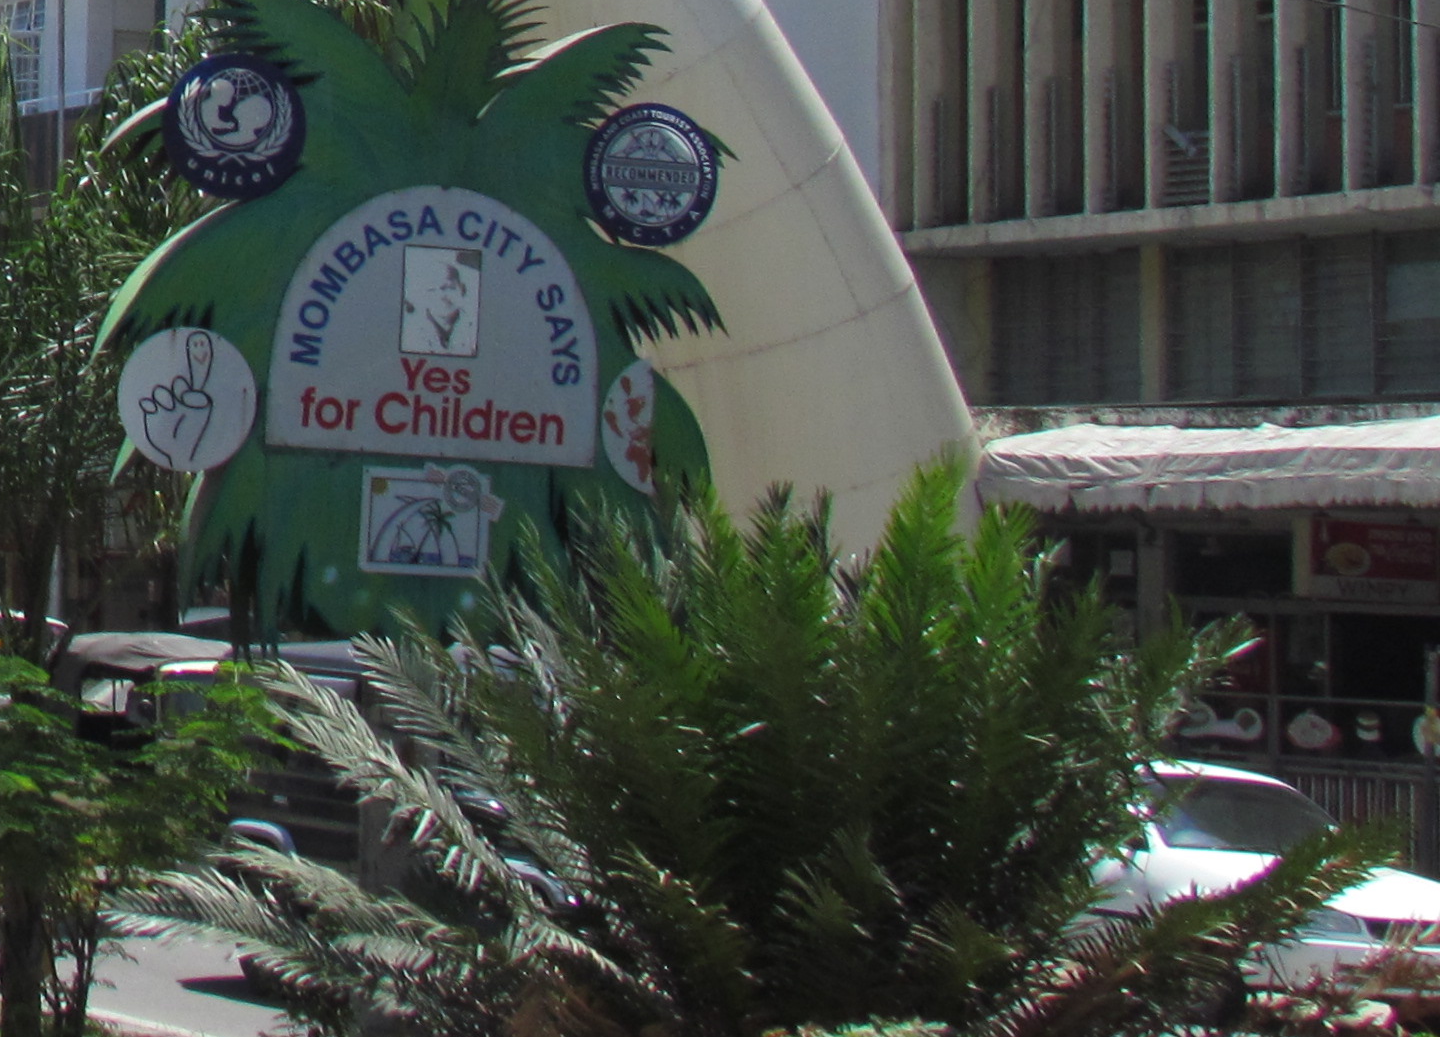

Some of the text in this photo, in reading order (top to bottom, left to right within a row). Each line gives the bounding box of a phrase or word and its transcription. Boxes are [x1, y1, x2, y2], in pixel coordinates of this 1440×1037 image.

[605, 165, 697, 185] RECOMMENDED
[651, 110, 691, 132] TOURIST
[688, 131, 714, 200] ASSOCIATION
[290, 205, 581, 387] MOMBASA CITY SAYS
[400, 357, 472, 396] Yes
[300, 386, 565, 446] for Children
